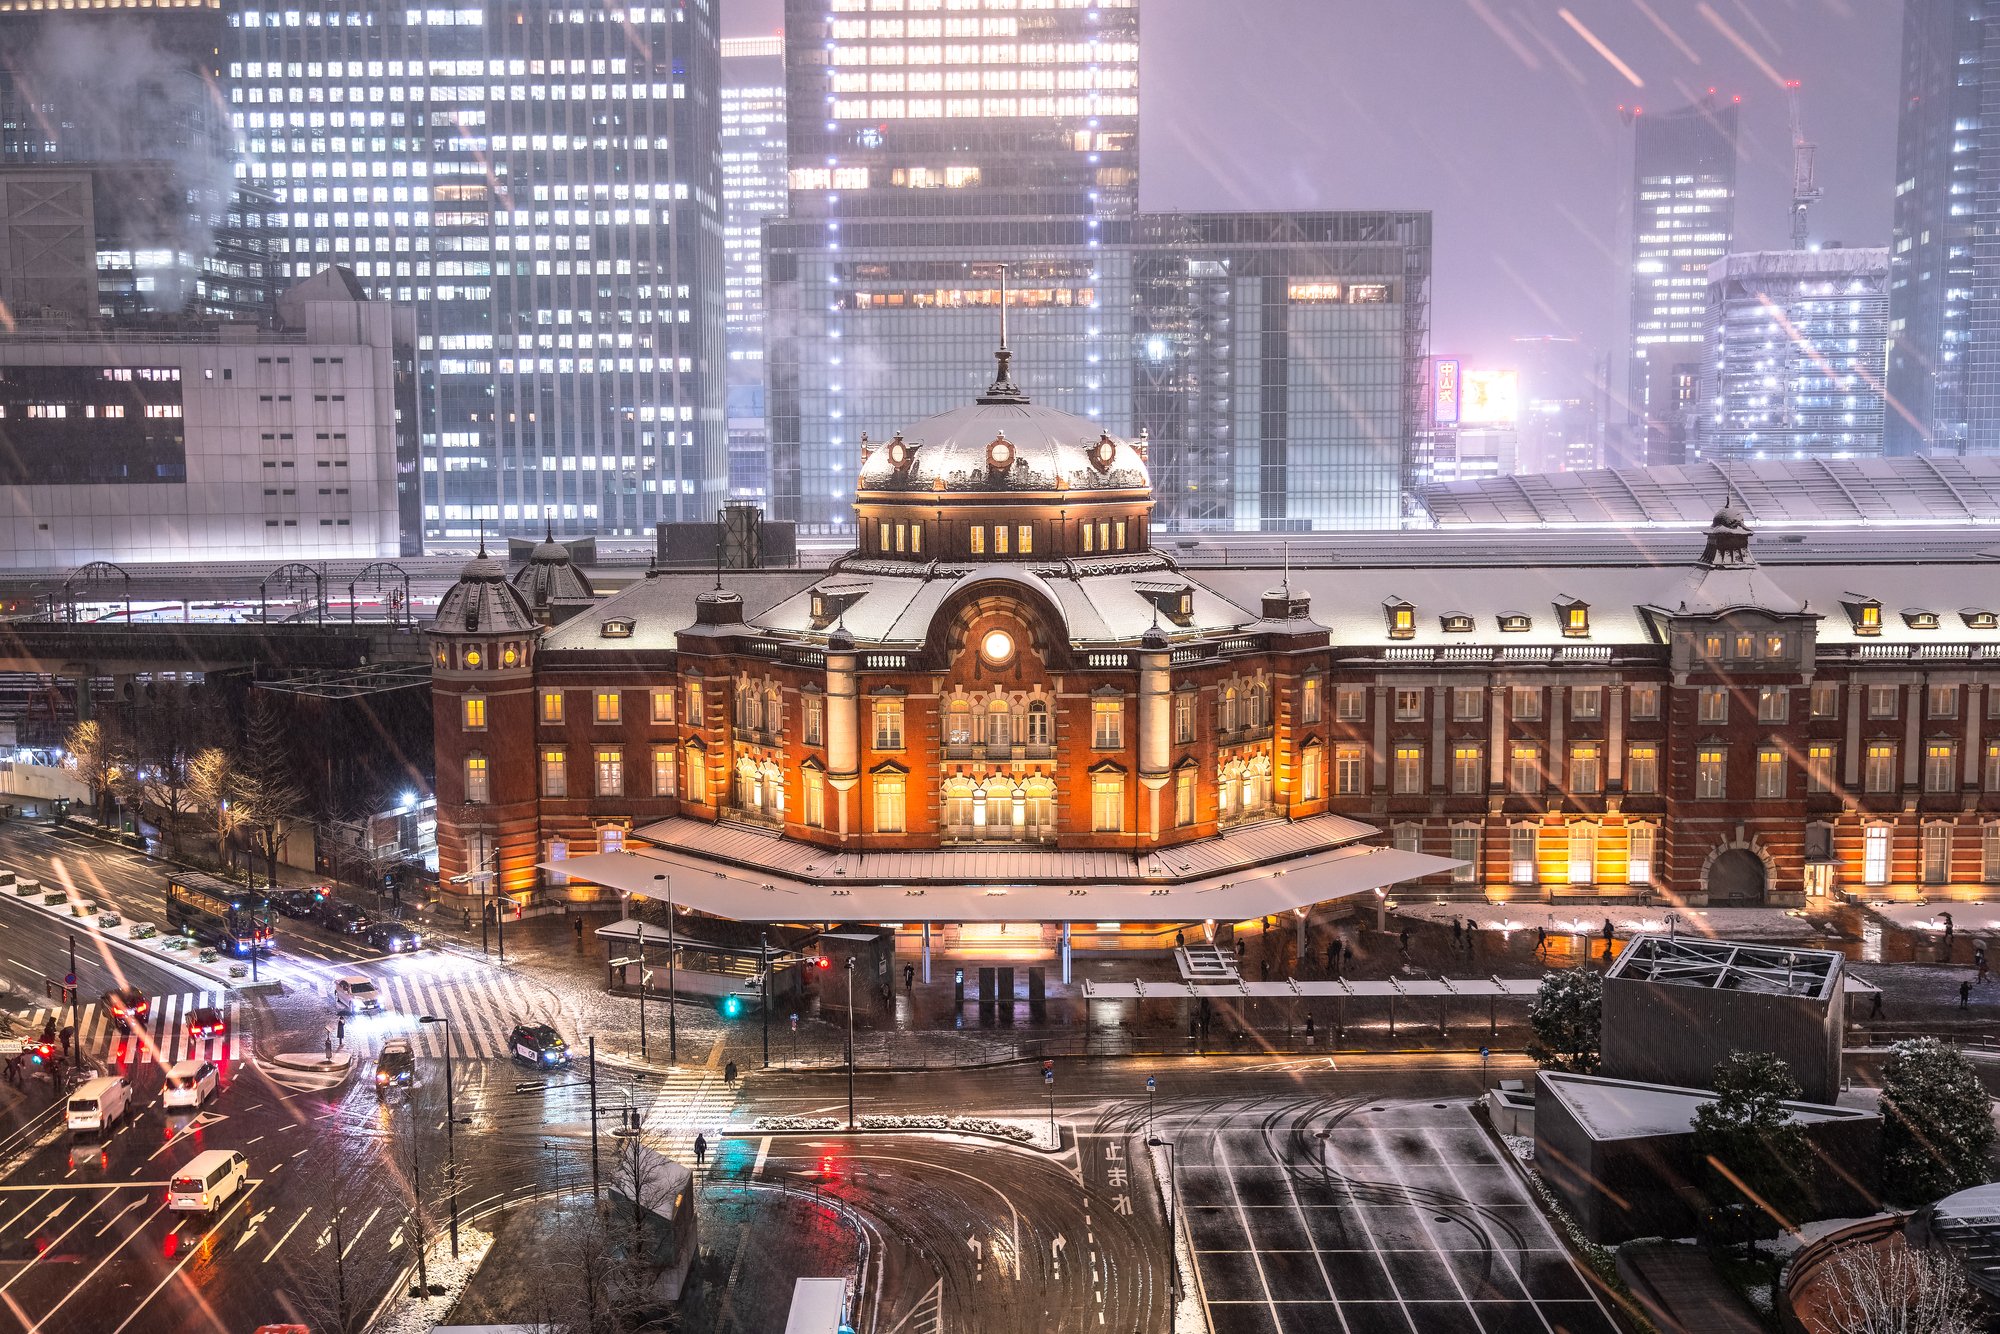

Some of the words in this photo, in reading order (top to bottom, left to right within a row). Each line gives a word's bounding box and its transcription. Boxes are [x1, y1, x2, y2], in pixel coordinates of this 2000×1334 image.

[1439, 363, 1454, 403] 中山式
[1105, 1141, 1133, 1215] 止まれ
